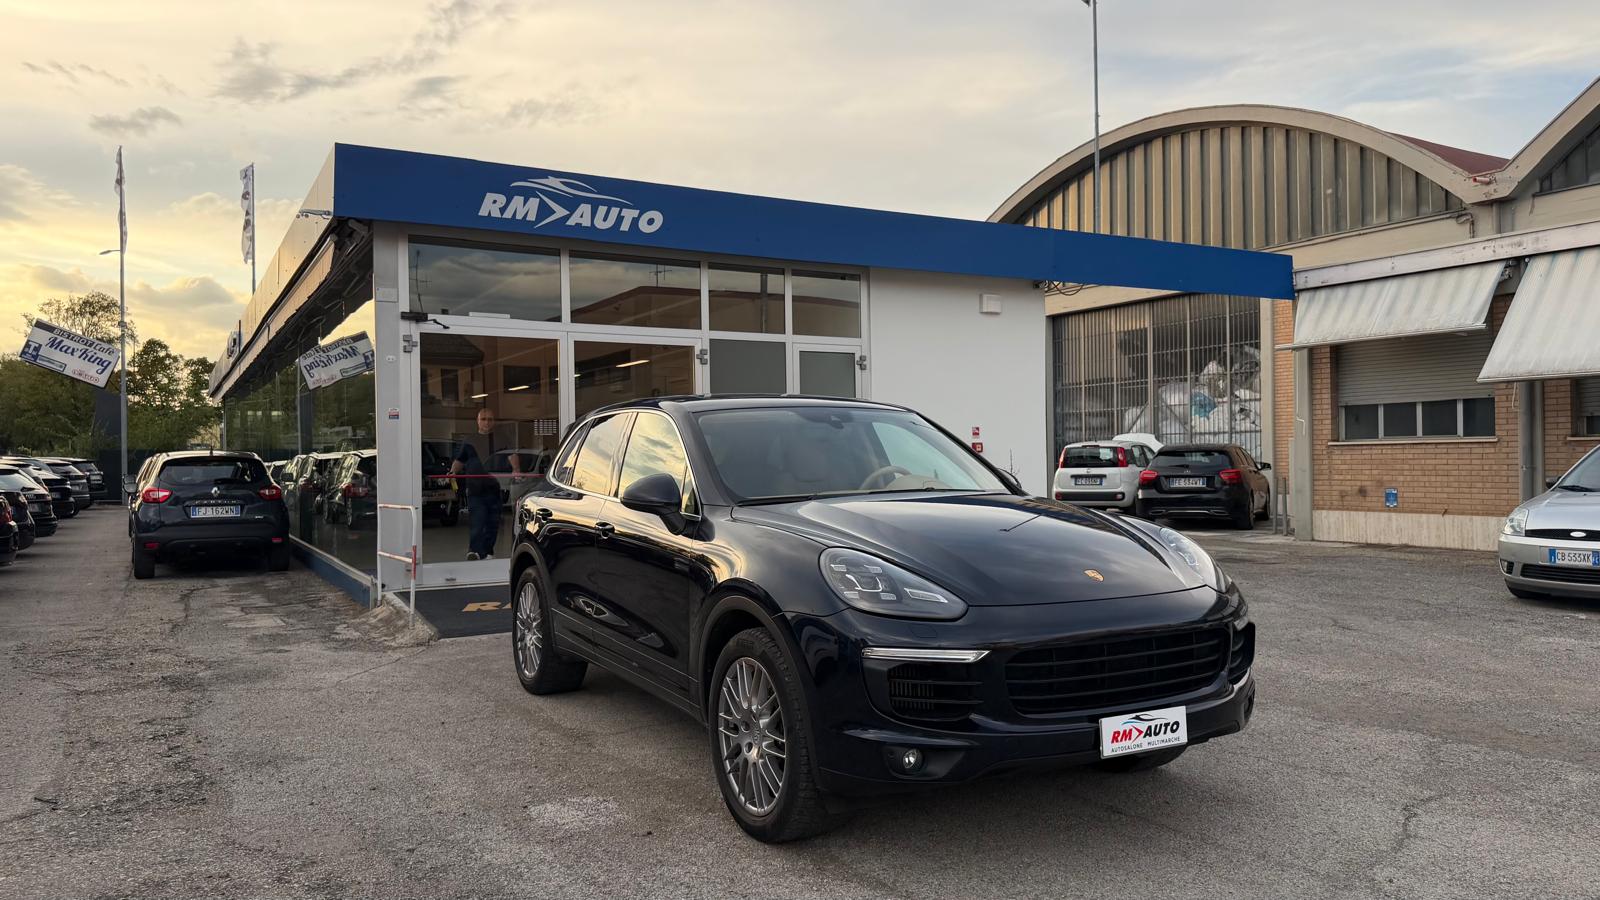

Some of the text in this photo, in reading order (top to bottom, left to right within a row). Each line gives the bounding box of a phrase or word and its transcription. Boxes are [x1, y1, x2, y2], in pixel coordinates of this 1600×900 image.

[478, 192, 665, 234] RM AUTO
[53, 328, 94, 348] BISTROT
[45, 336, 80, 356] Max
[78, 347, 113, 375] King
[1567, 552, 1592, 563] 533XK
[1111, 721, 1180, 744] RM AUTO
